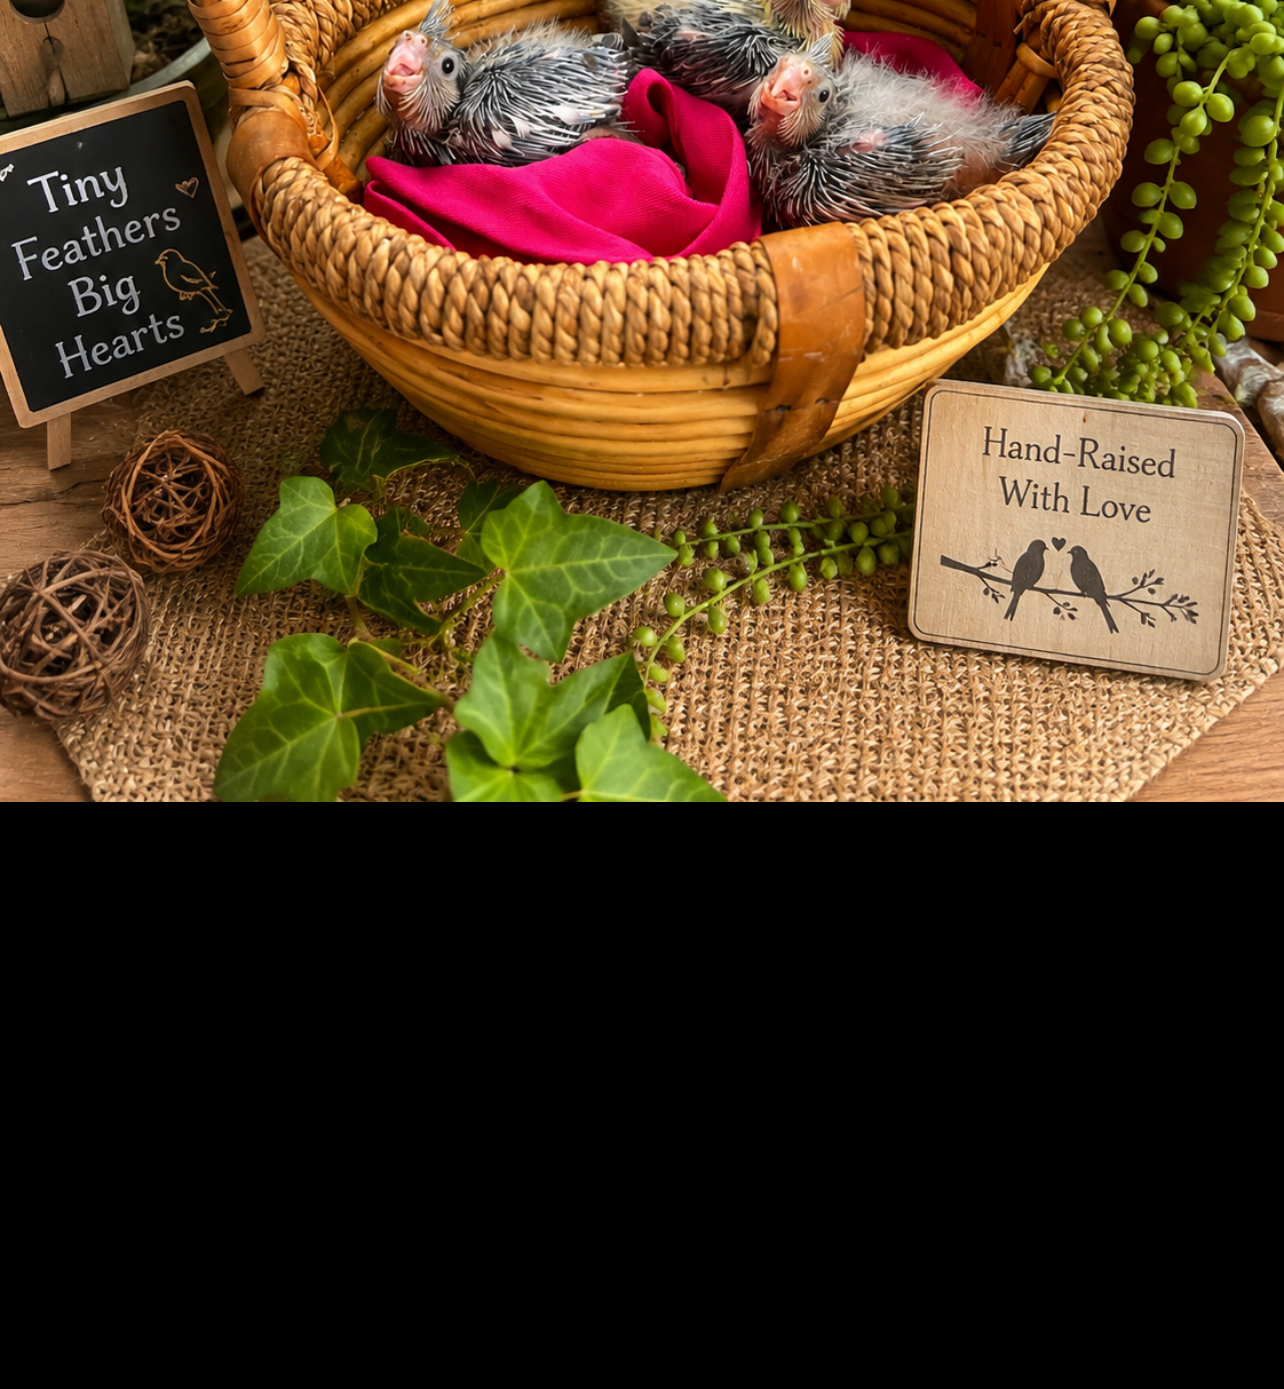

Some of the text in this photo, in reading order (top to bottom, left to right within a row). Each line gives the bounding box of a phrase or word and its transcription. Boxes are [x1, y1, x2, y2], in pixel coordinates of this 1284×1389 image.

[27, 166, 129, 213] Tiny
[11, 207, 182, 281] Feathers
[67, 274, 142, 317] Big
[55, 313, 185, 379] Hearts
[982, 426, 1176, 478] Hand-Raised
[998, 475, 1151, 523] With Love
